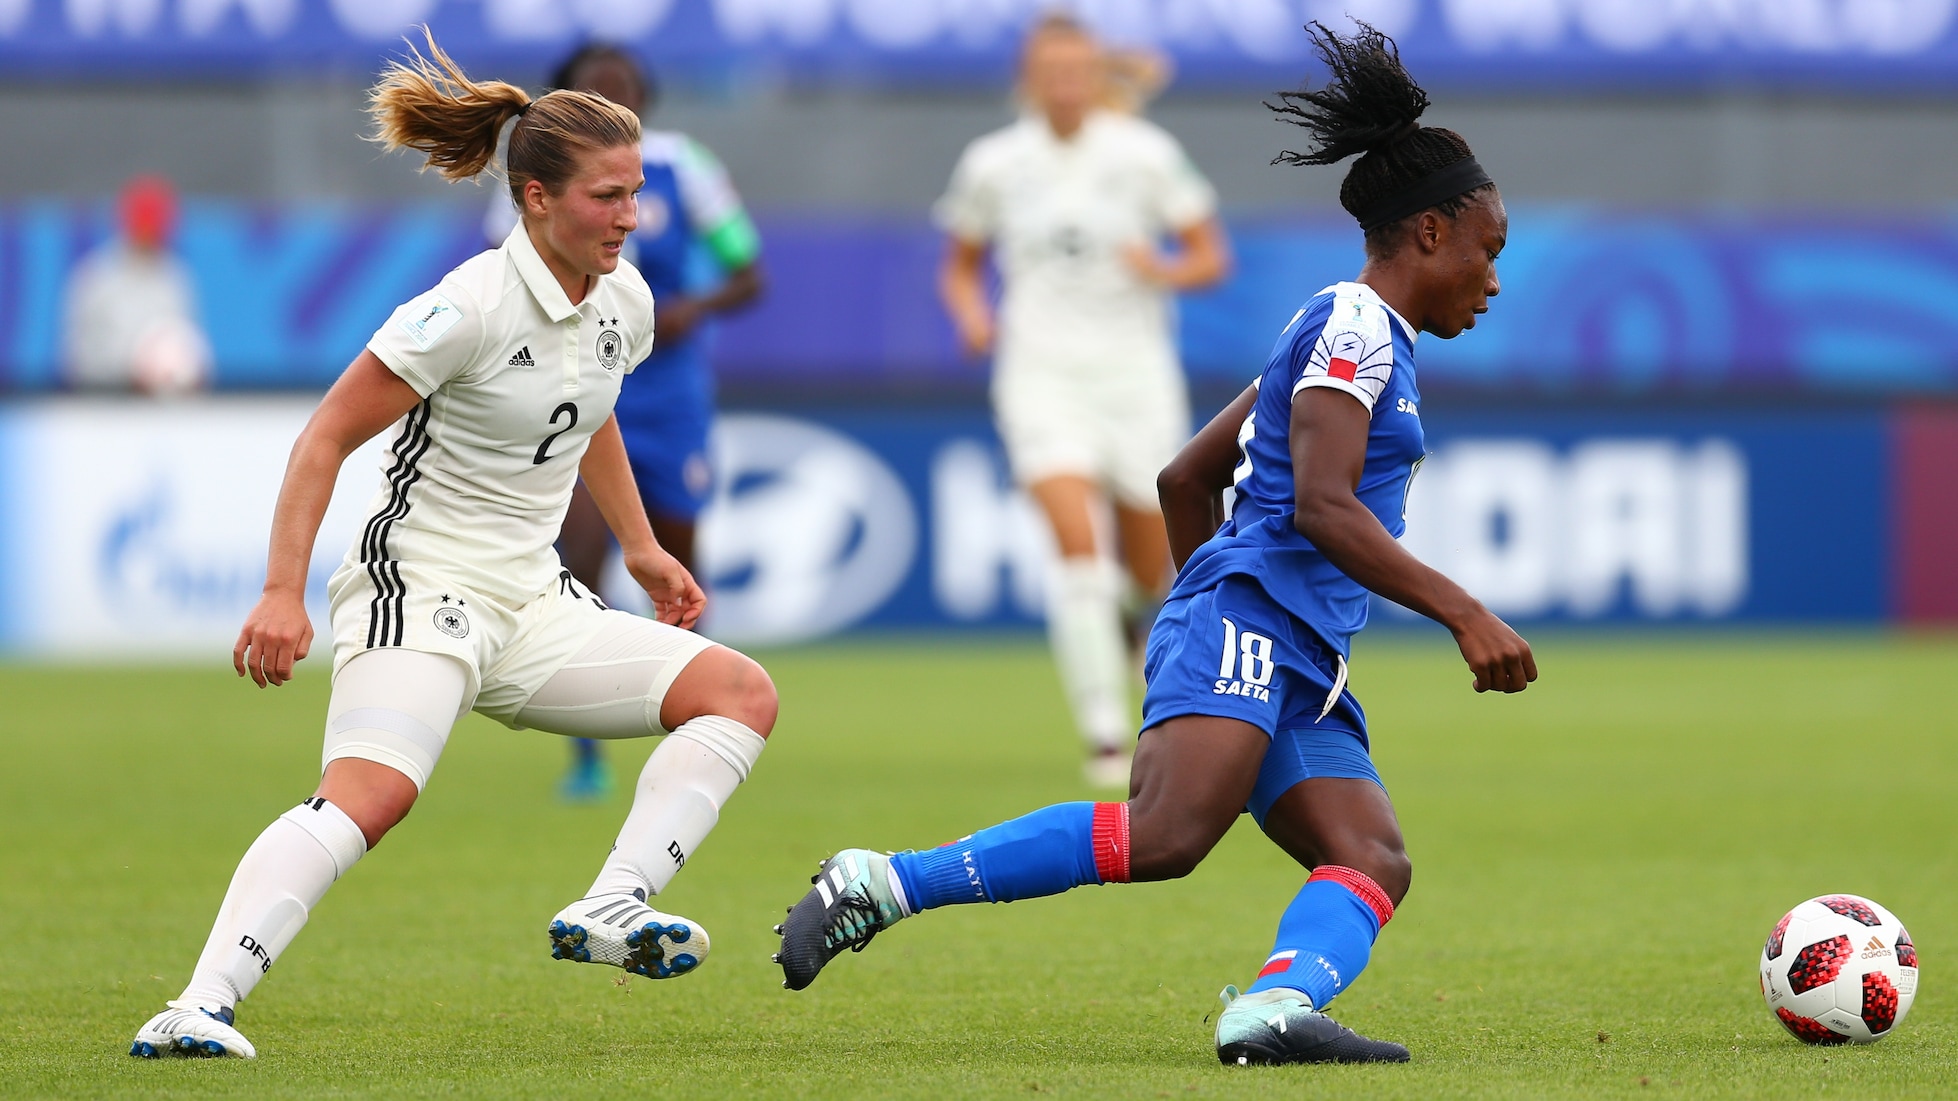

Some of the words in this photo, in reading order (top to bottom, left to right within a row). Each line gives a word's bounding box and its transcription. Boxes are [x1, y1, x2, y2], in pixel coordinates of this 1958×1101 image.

[508, 358, 535, 367] adidas
[532, 402, 578, 465] 2
[1219, 616, 1275, 687] 18
[1212, 679, 1270, 704] SAETA
[667, 840, 685, 873] DF
[239, 935, 271, 974] DFB
[1861, 949, 1892, 960] adidas
